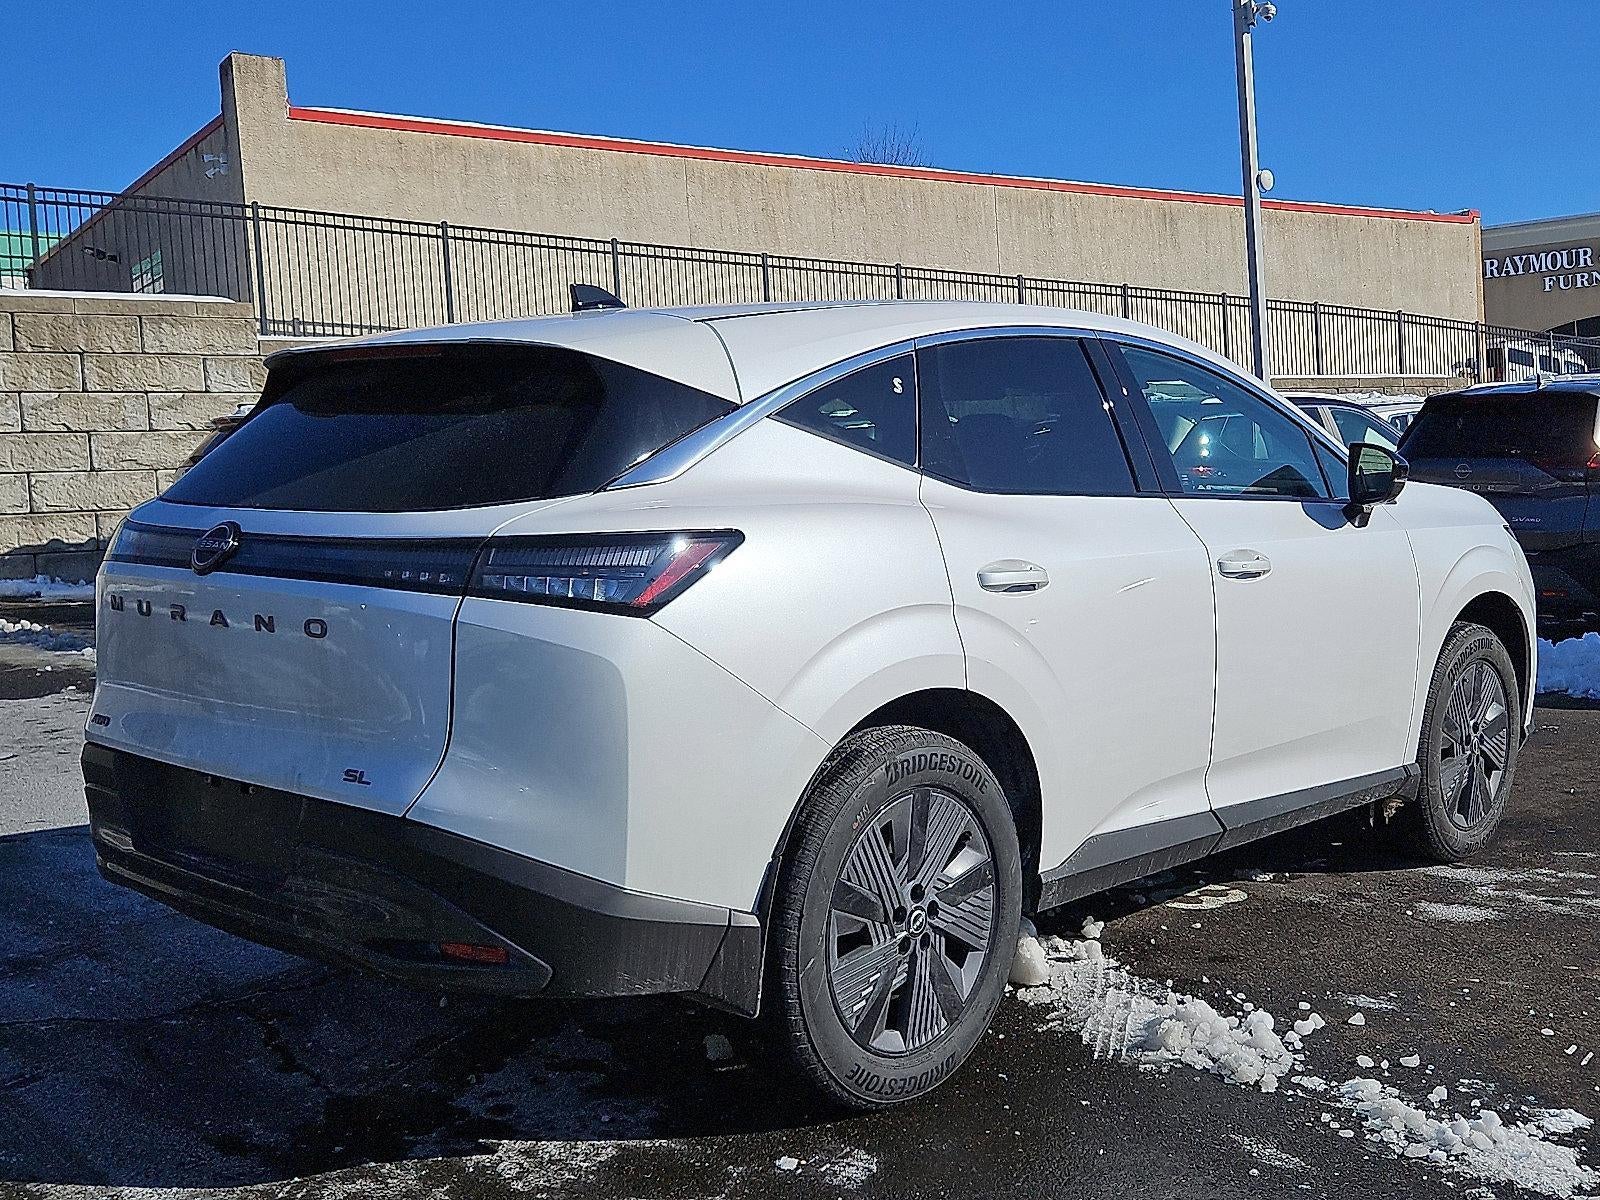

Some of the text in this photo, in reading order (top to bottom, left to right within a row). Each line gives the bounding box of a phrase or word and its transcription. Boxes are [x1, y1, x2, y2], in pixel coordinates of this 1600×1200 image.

[1484, 247, 1594, 279] RAYMOUR
[893, 377, 903, 394] S
[110, 594, 329, 639] MURANO
[342, 768, 372, 786] SL
[885, 753, 989, 794] BRIDGESTONE
[845, 1051, 957, 1096] BRIDGESTONE
